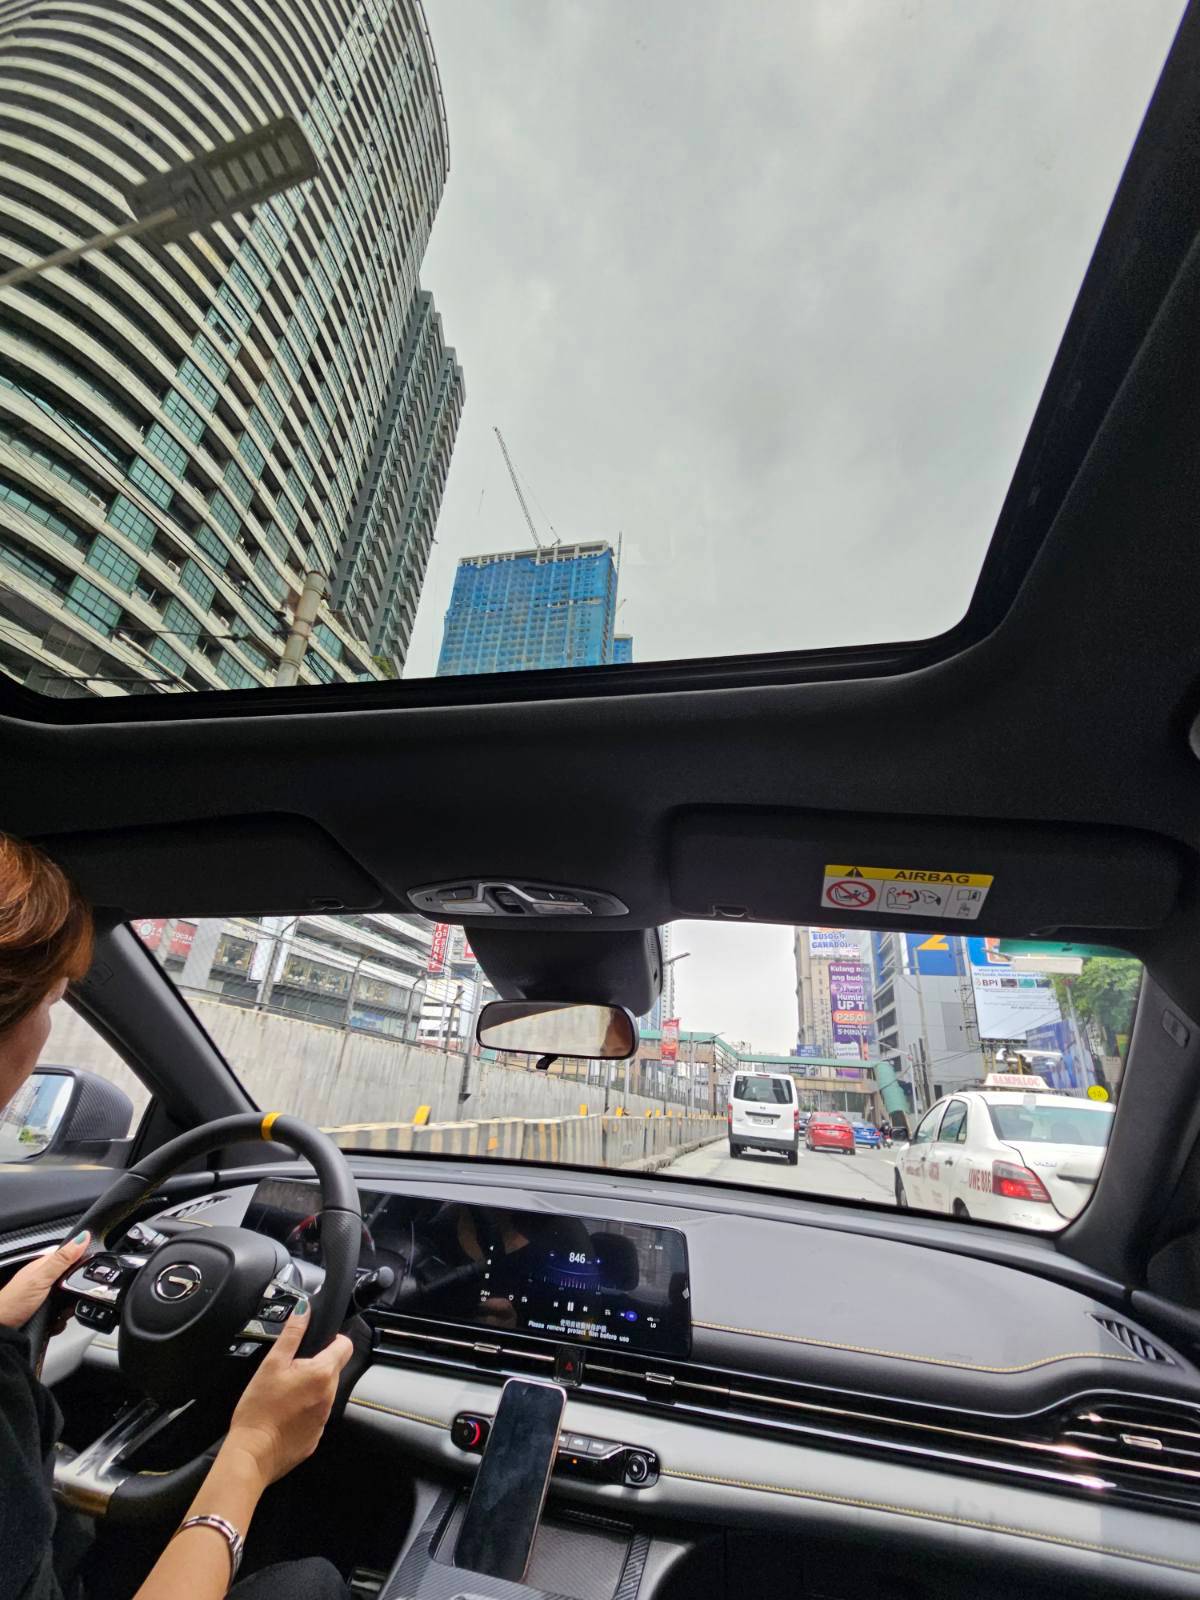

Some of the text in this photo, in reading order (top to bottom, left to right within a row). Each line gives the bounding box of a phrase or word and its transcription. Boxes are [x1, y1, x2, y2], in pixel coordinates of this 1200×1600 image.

[894, 870, 970, 884] AIRBAG
[830, 965, 855, 974] Kulang
[837, 1001, 854, 1010] UP
[568, 1252, 586, 1264] 846
[528, 1320, 545, 1329] Please
[546, 1324, 566, 1332] remove
[567, 1328, 586, 1336] protect
[600, 1332, 617, 1341] before
